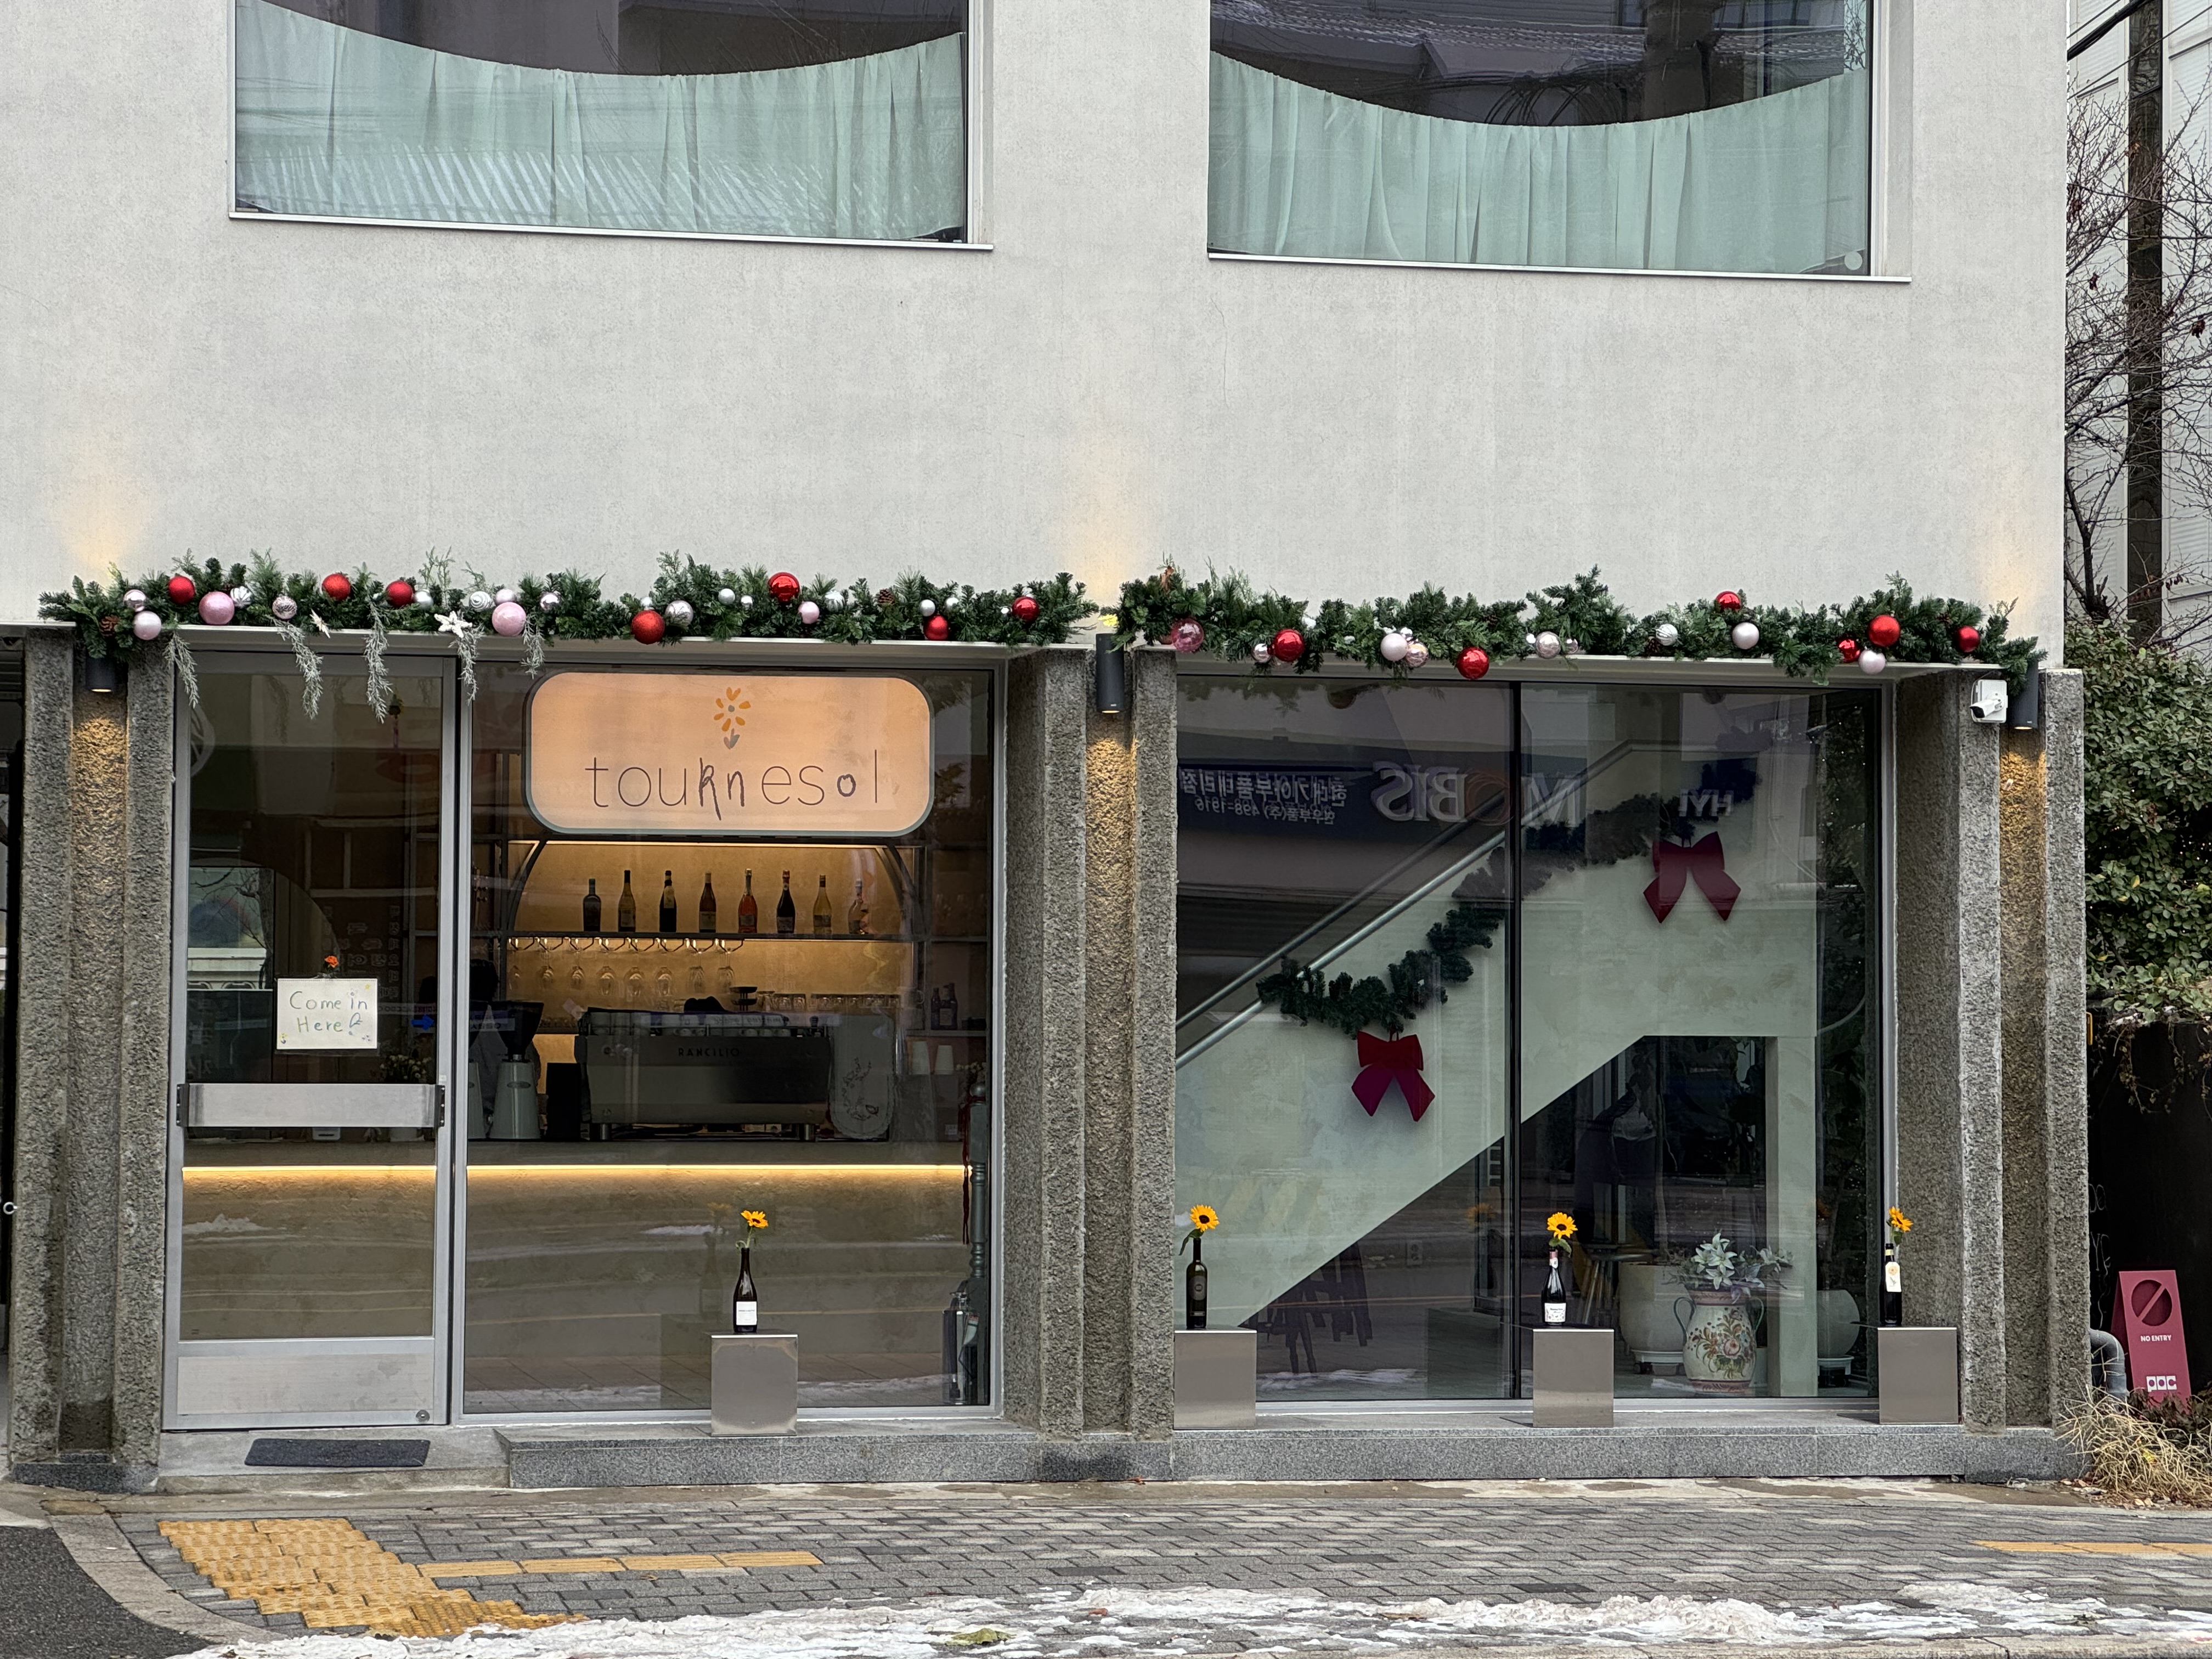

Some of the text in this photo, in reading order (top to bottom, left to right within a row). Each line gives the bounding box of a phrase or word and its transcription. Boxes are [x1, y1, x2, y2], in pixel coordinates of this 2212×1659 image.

[289, 991, 341, 1010] Come
[349, 991, 368, 1010] in
[678, 1047, 740, 1057] RANCILIO
